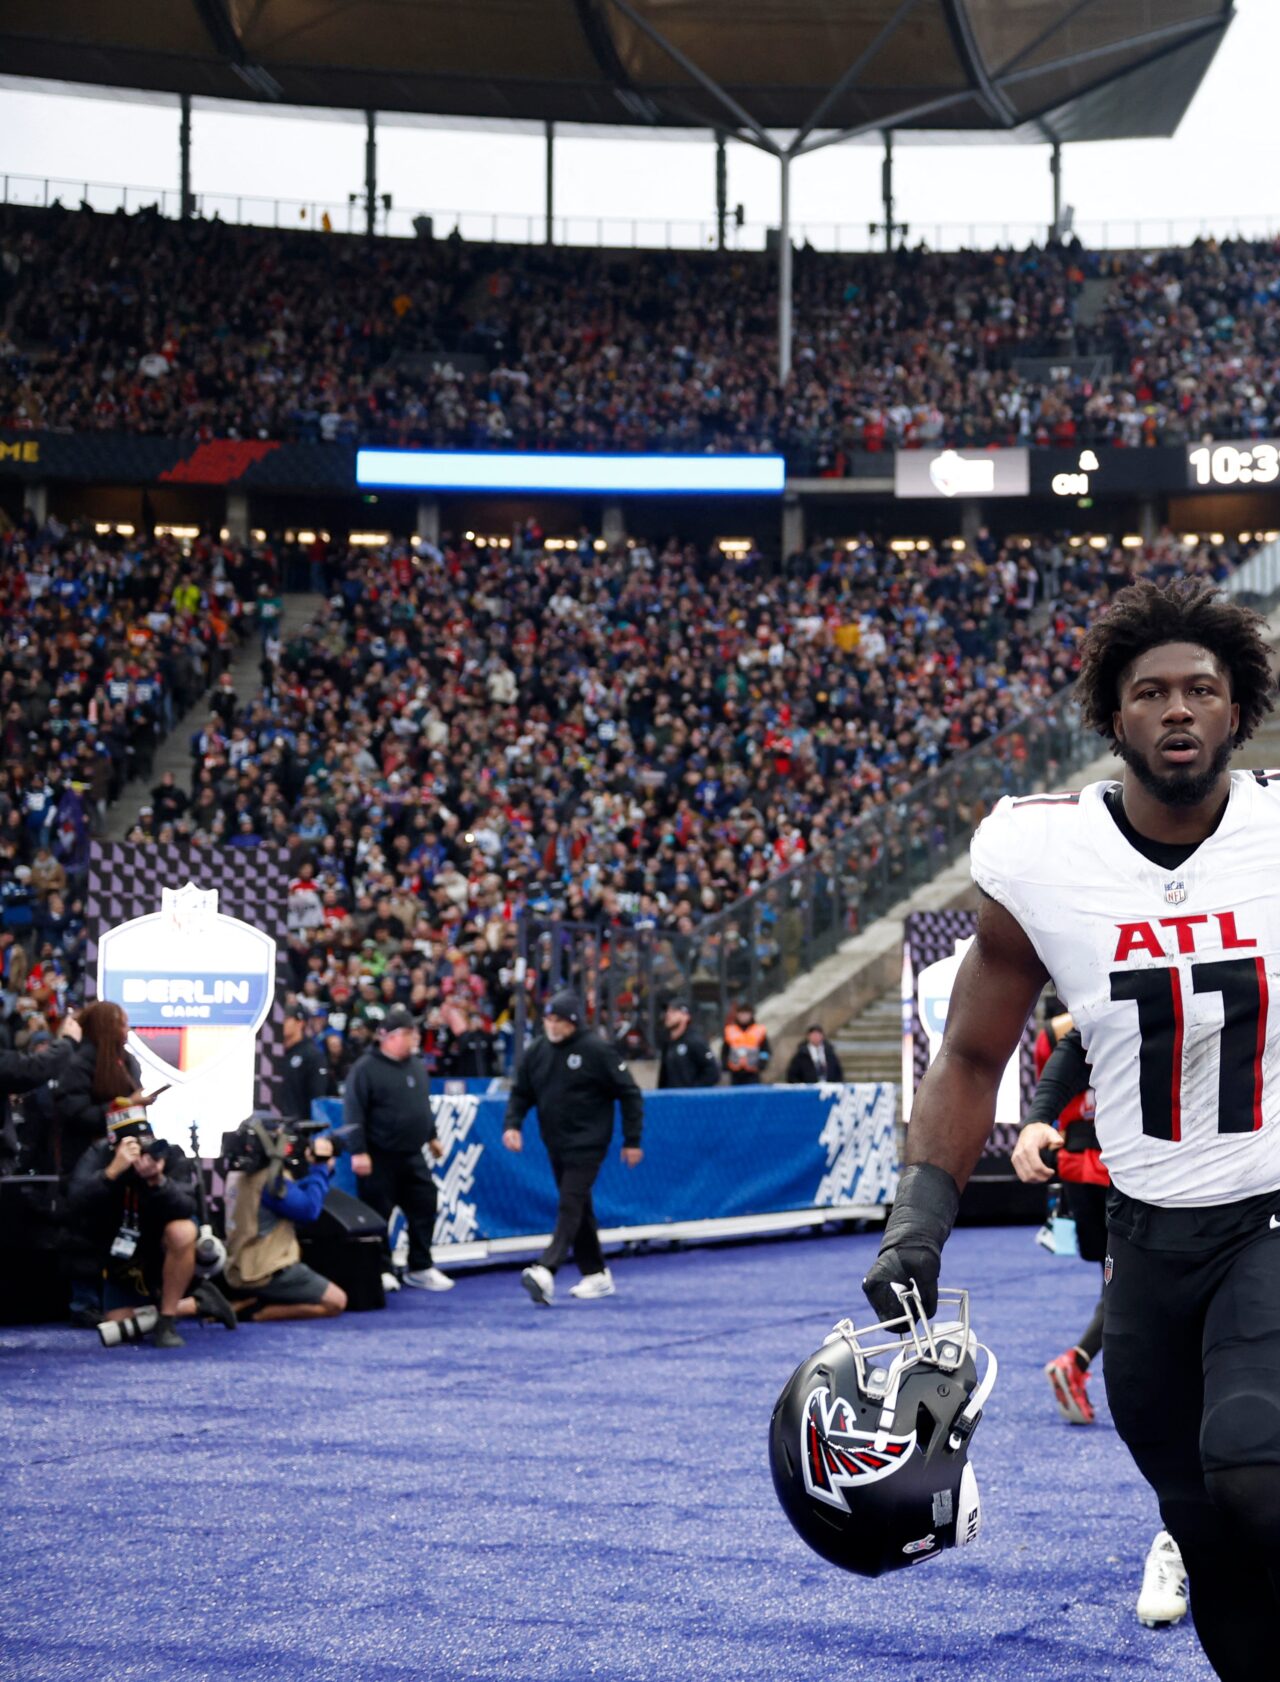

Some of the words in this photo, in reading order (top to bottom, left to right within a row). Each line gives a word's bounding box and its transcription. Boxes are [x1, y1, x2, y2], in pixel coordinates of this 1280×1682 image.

[1167, 890, 1185, 902] NFL
[1113, 911, 1258, 962] ATL
[122, 978, 250, 1005] BERLIN
[160, 1005, 211, 1018] GAME
[1110, 956, 1271, 1143] 11
